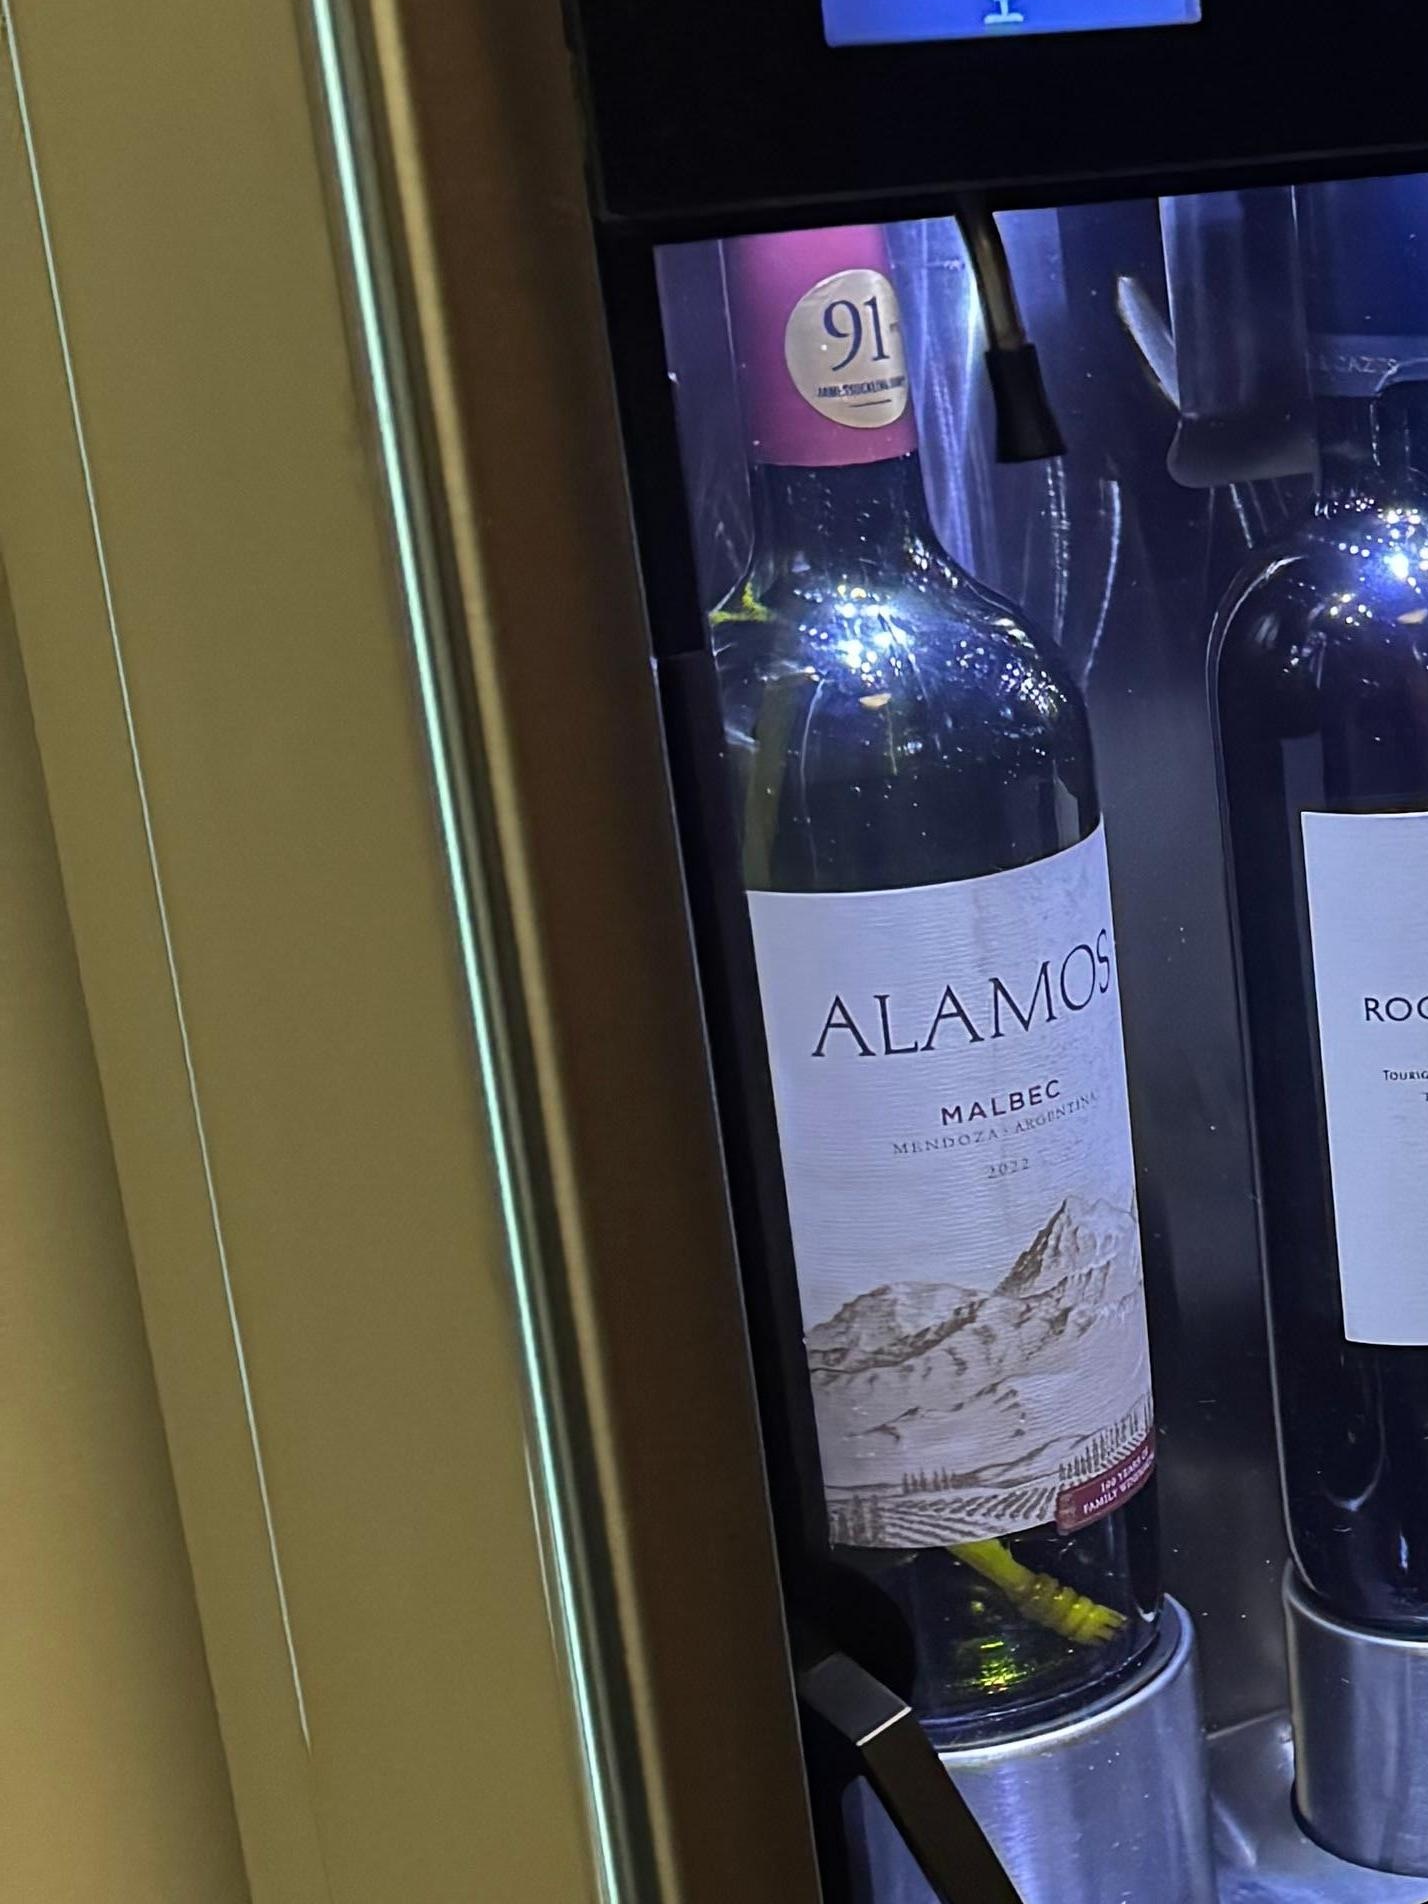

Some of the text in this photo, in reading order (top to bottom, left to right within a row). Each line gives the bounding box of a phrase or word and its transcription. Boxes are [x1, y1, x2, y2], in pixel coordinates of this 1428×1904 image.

[823, 296, 890, 372] 91
[811, 928, 1110, 1058] ALAMOS
[941, 1080, 1061, 1126] MALBEC
[893, 1128, 998, 1156] MENDOZA
[1083, 1489, 1118, 1514] FAMILY
